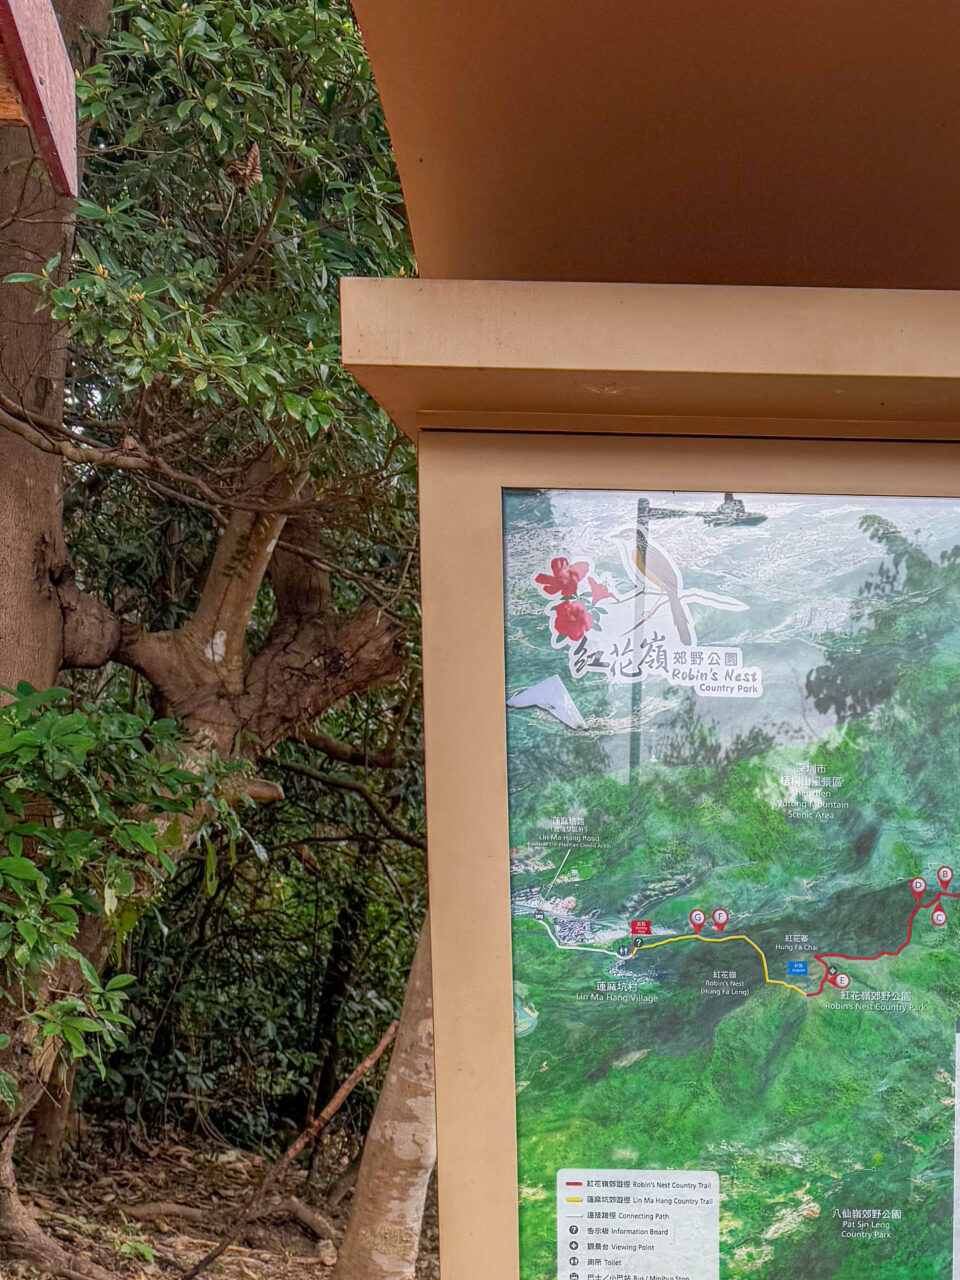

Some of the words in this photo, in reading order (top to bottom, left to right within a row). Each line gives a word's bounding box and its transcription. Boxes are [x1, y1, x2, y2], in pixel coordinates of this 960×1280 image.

[574, 632, 669, 678] 紅花嶺
[673, 652, 738, 667] 郊野公園
[672, 668, 718, 684] Robin's
[725, 670, 758, 683] Nest
[700, 683, 735, 695] Country
[738, 683, 758, 694] Park
[672, 1182, 697, 1190] Country
[618, 1213, 654, 1221] Connecting
[611, 1244, 637, 1252] Viewing
